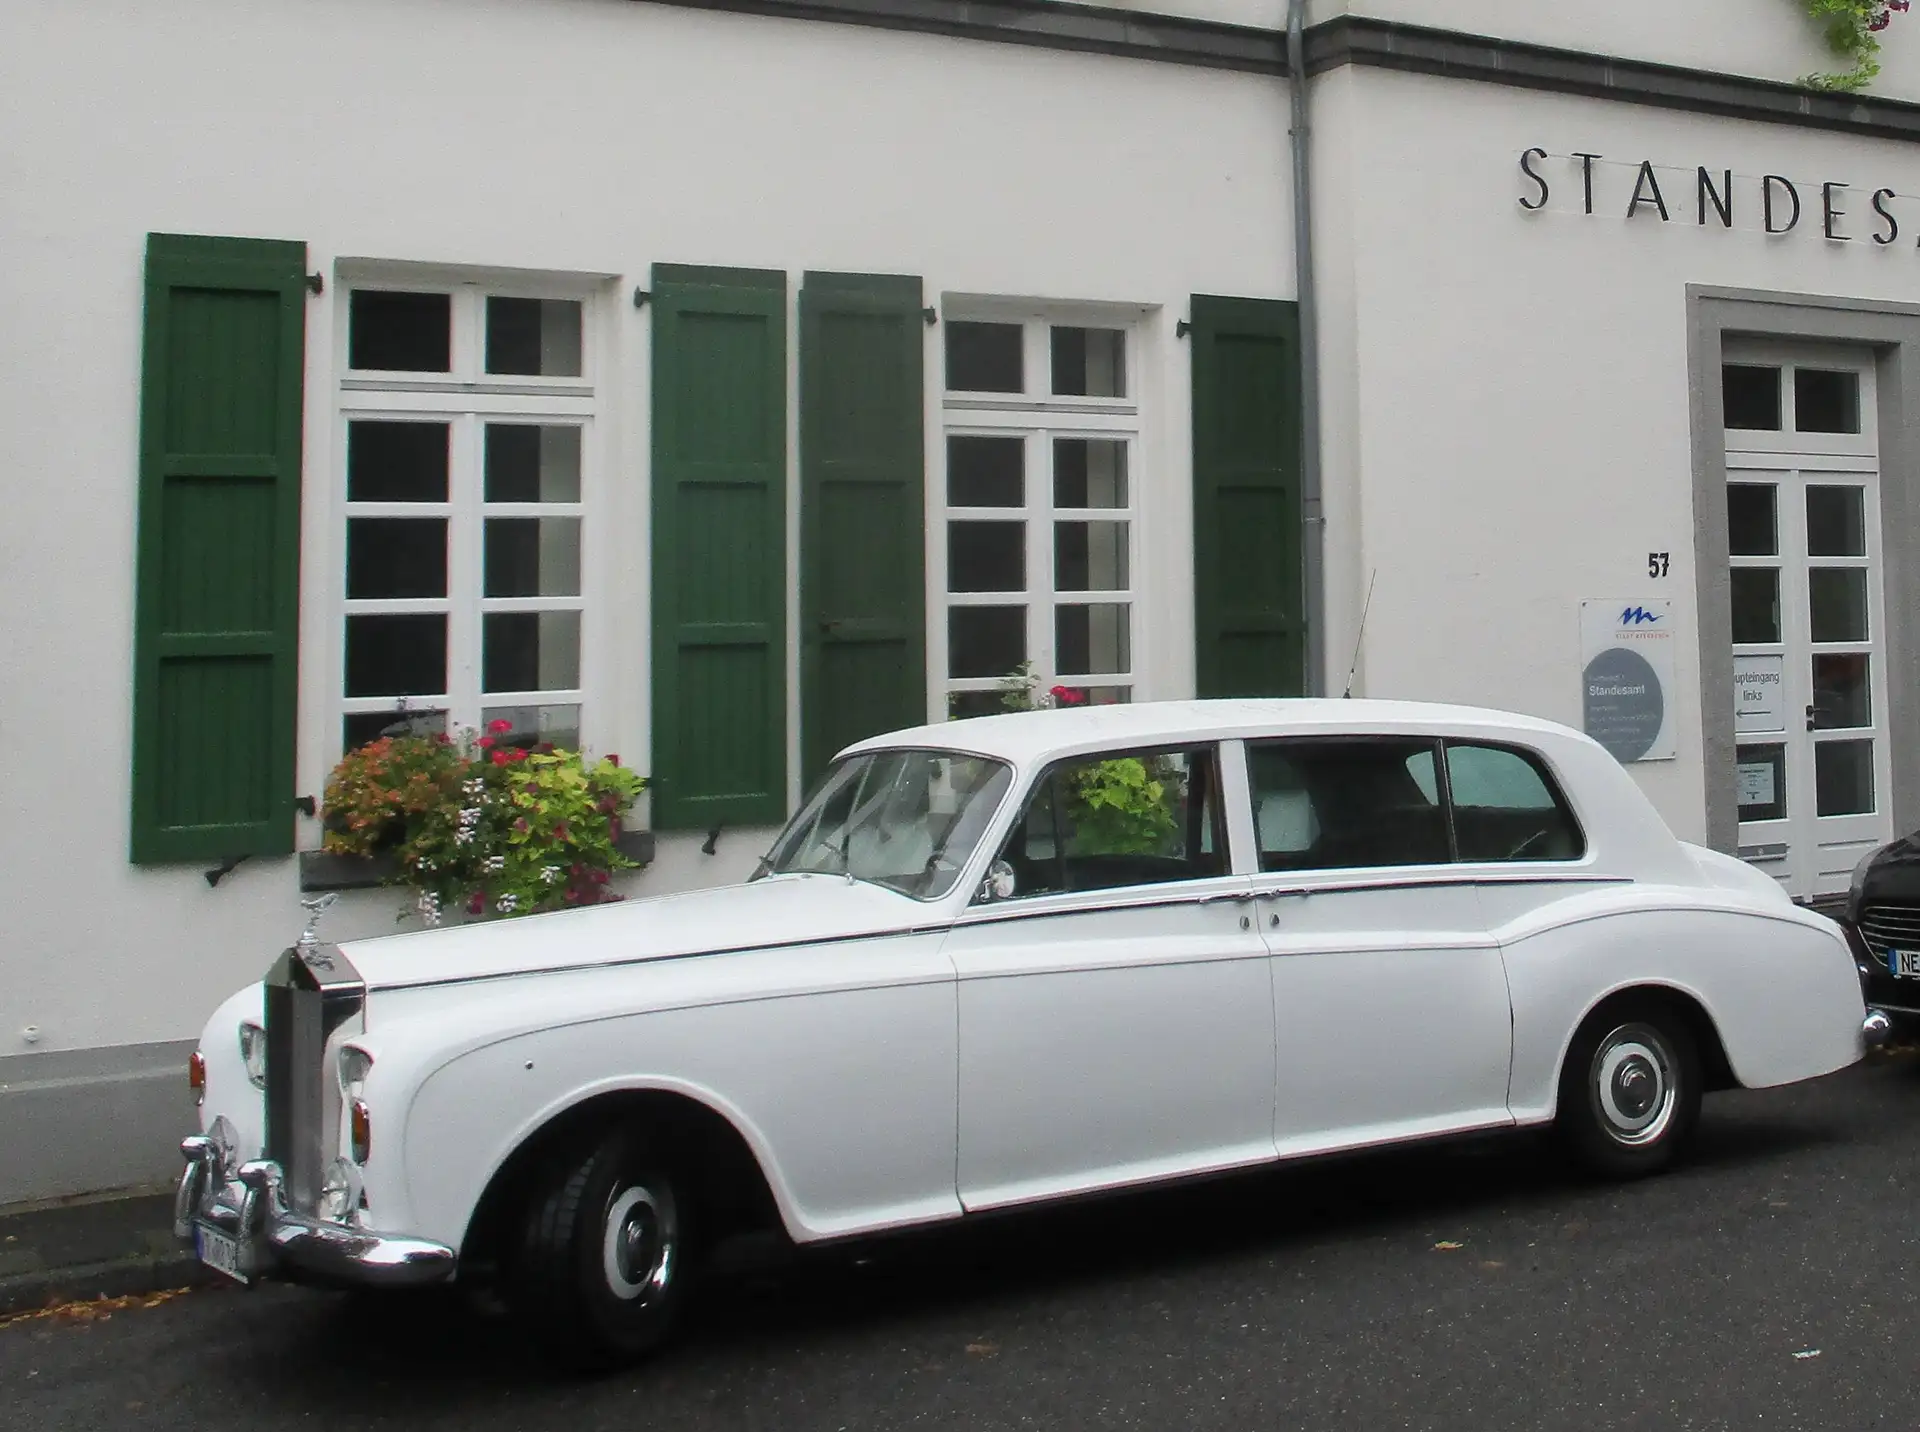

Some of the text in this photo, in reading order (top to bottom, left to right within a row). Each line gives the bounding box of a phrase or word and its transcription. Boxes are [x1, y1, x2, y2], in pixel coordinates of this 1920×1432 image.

[1518, 147, 1920, 247] STANDES
[1648, 552, 1669, 578] 57
[1734, 671, 1780, 685] upteingang
[1589, 684, 1645, 696] Standesamt
[1743, 690, 1763, 701] links
[1901, 953, 1919, 973] NE
